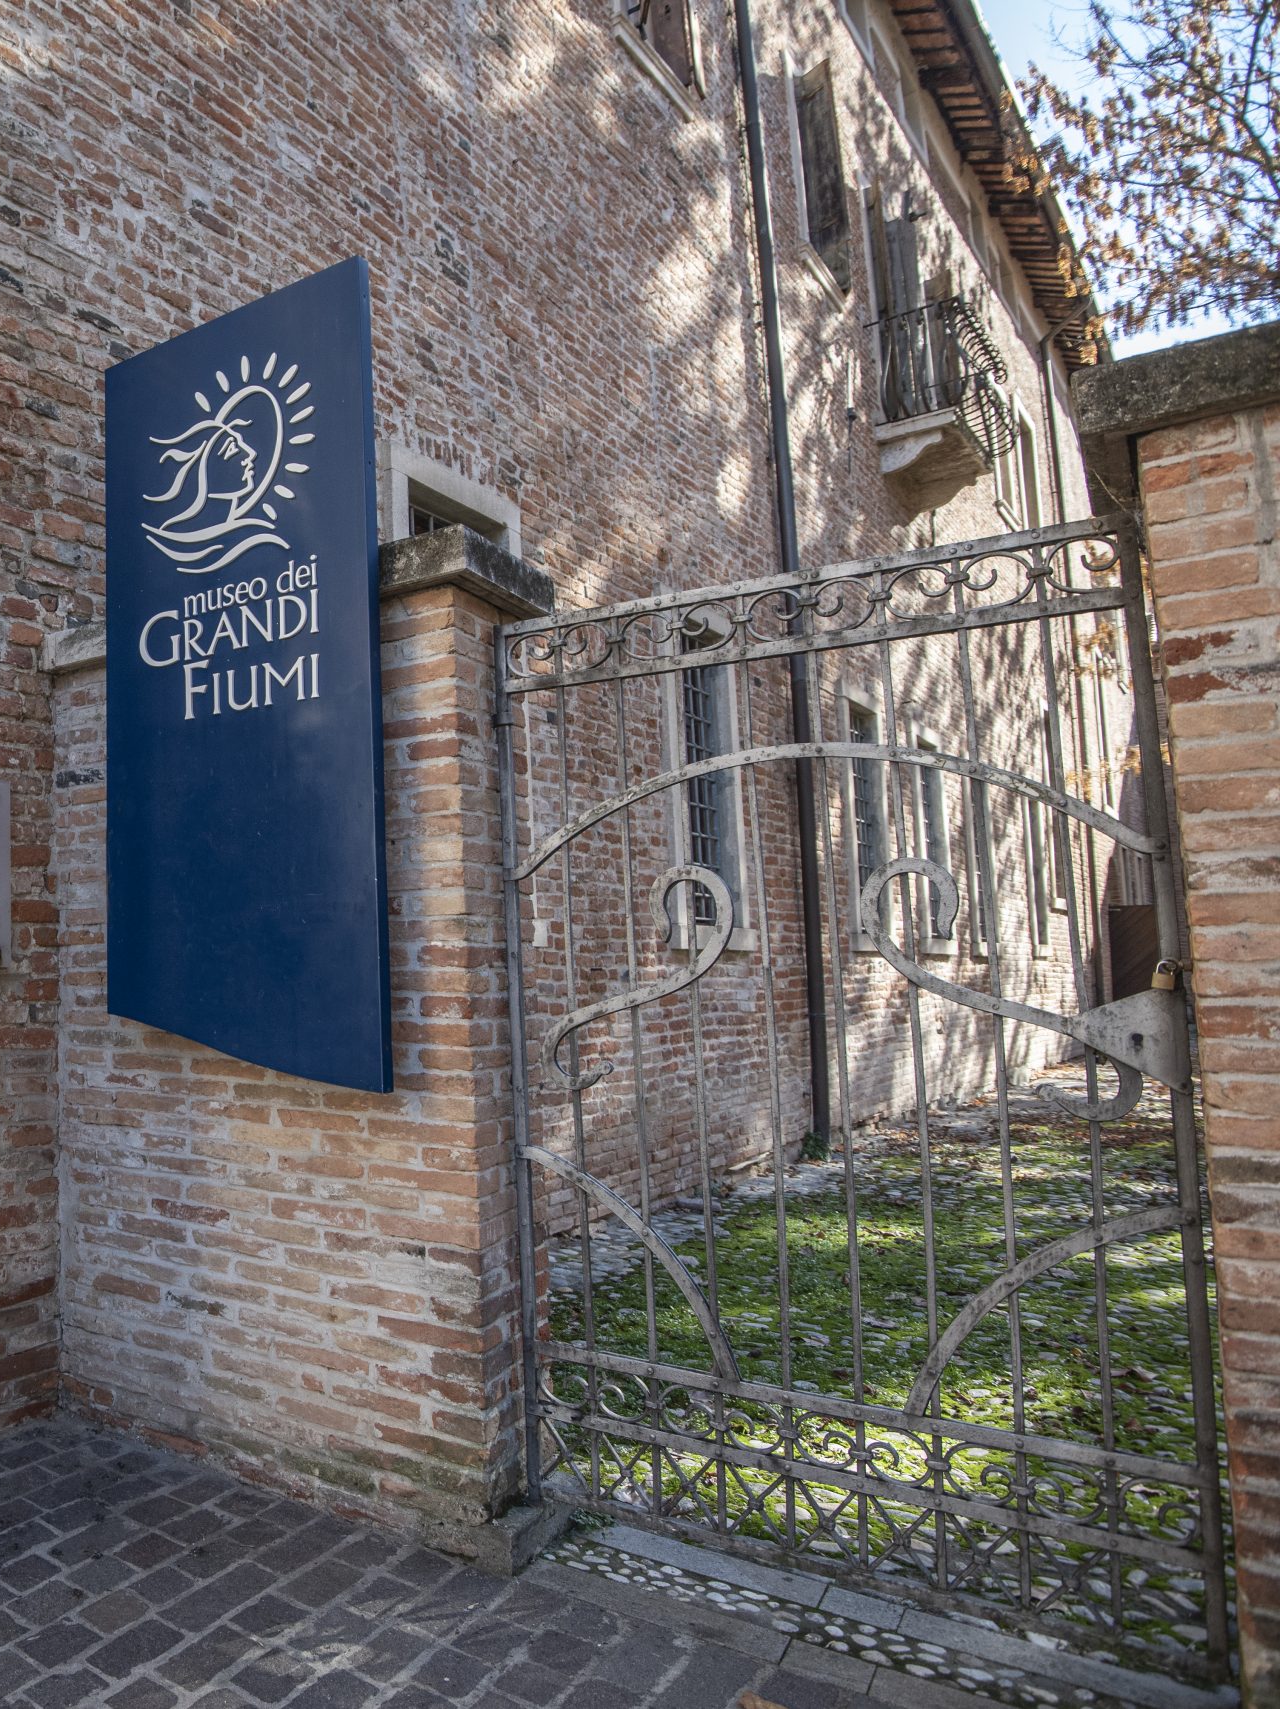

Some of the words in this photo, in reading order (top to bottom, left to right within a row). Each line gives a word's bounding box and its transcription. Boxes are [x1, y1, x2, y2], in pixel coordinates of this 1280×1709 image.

[184, 577, 267, 618] museo
[276, 554, 318, 594] dei
[139, 589, 320, 667] GRANDI
[184, 653, 320, 720] FIUMI
